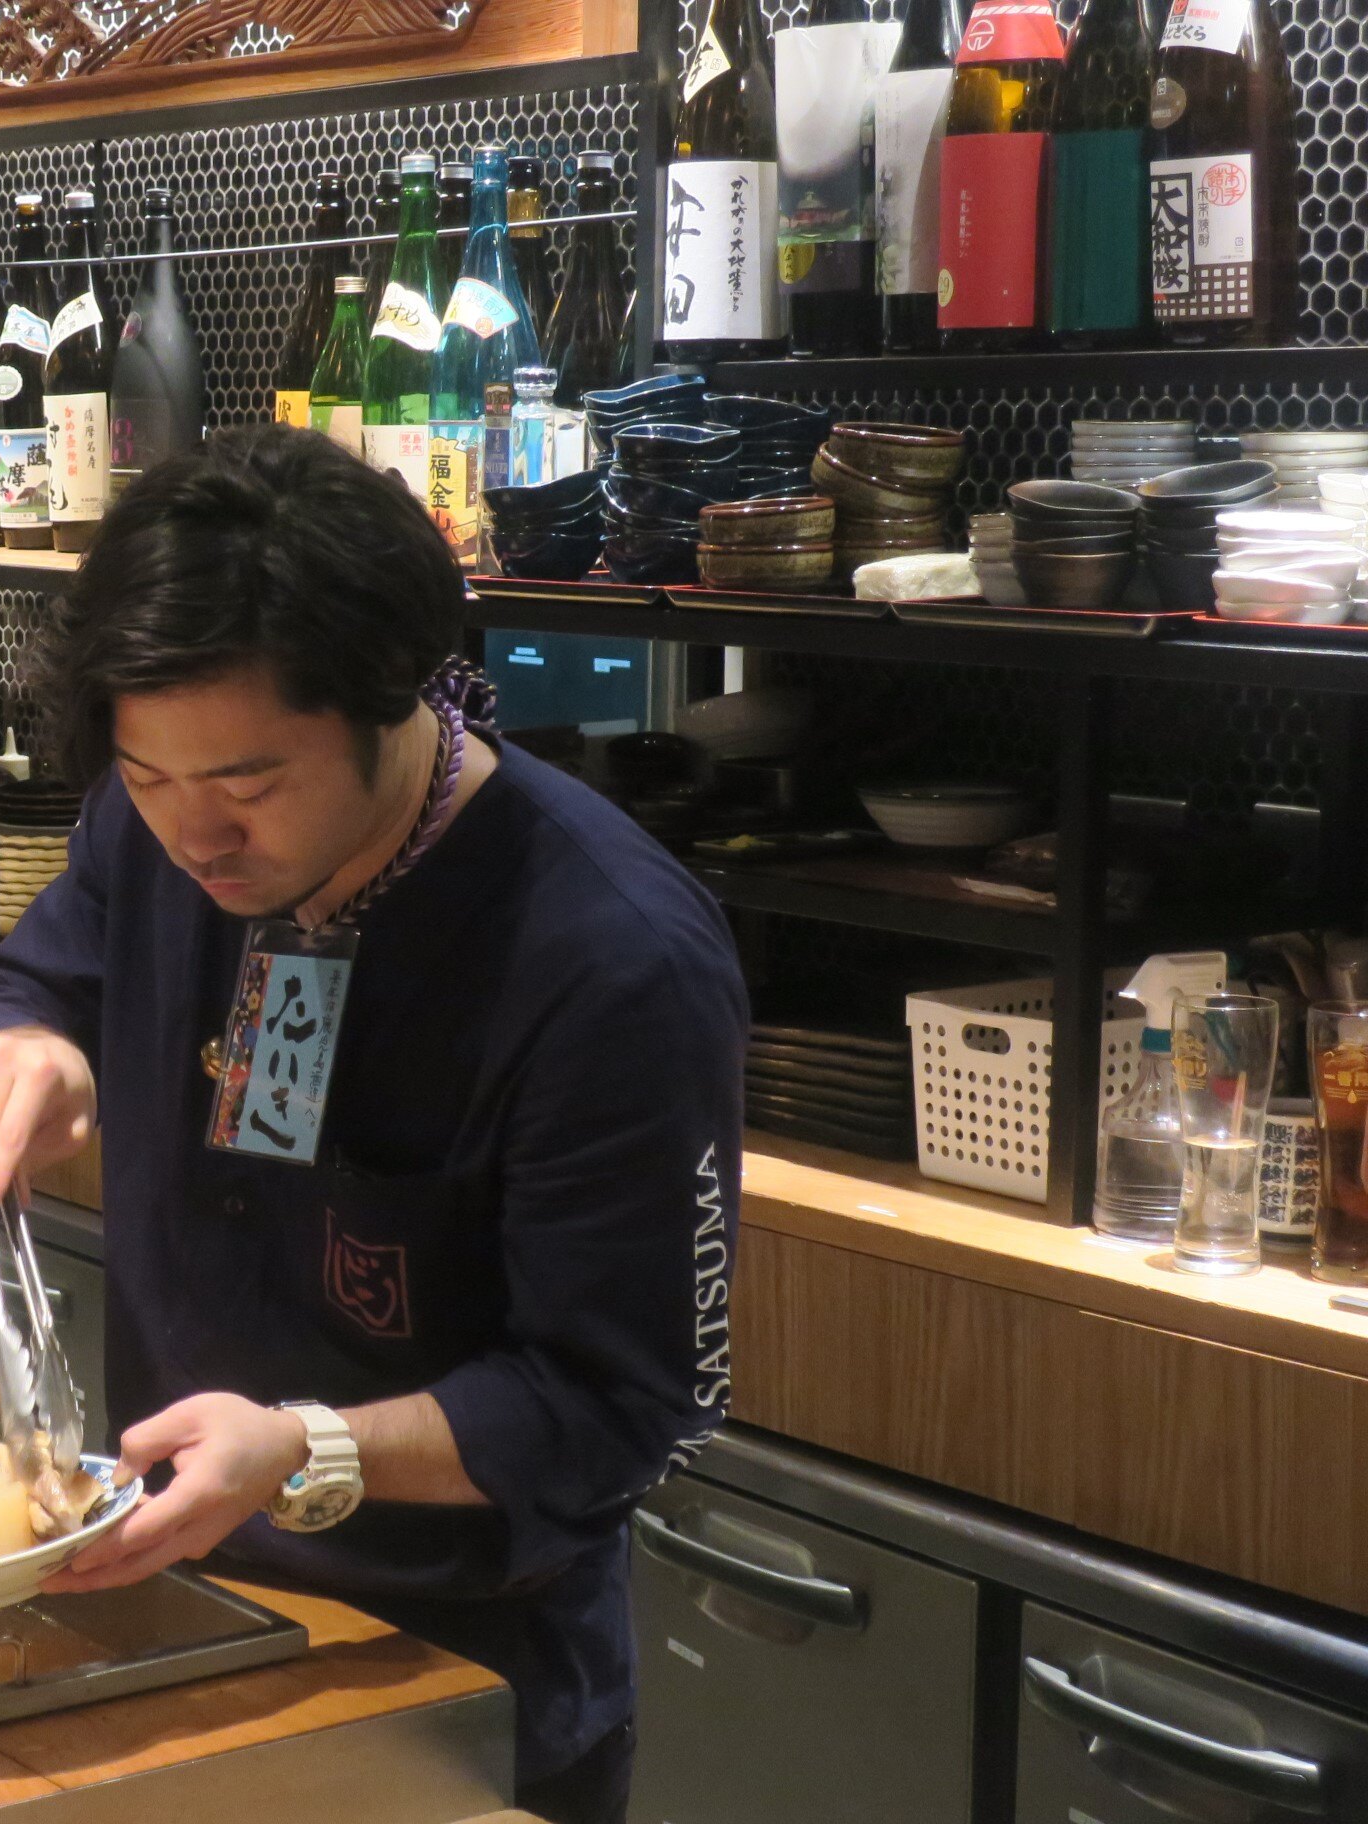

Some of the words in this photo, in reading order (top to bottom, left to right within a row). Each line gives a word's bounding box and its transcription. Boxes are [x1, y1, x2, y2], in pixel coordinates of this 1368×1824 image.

[1152, 181, 1190, 290] 大和桜
[694, 1141, 731, 1408] SATSUMA
